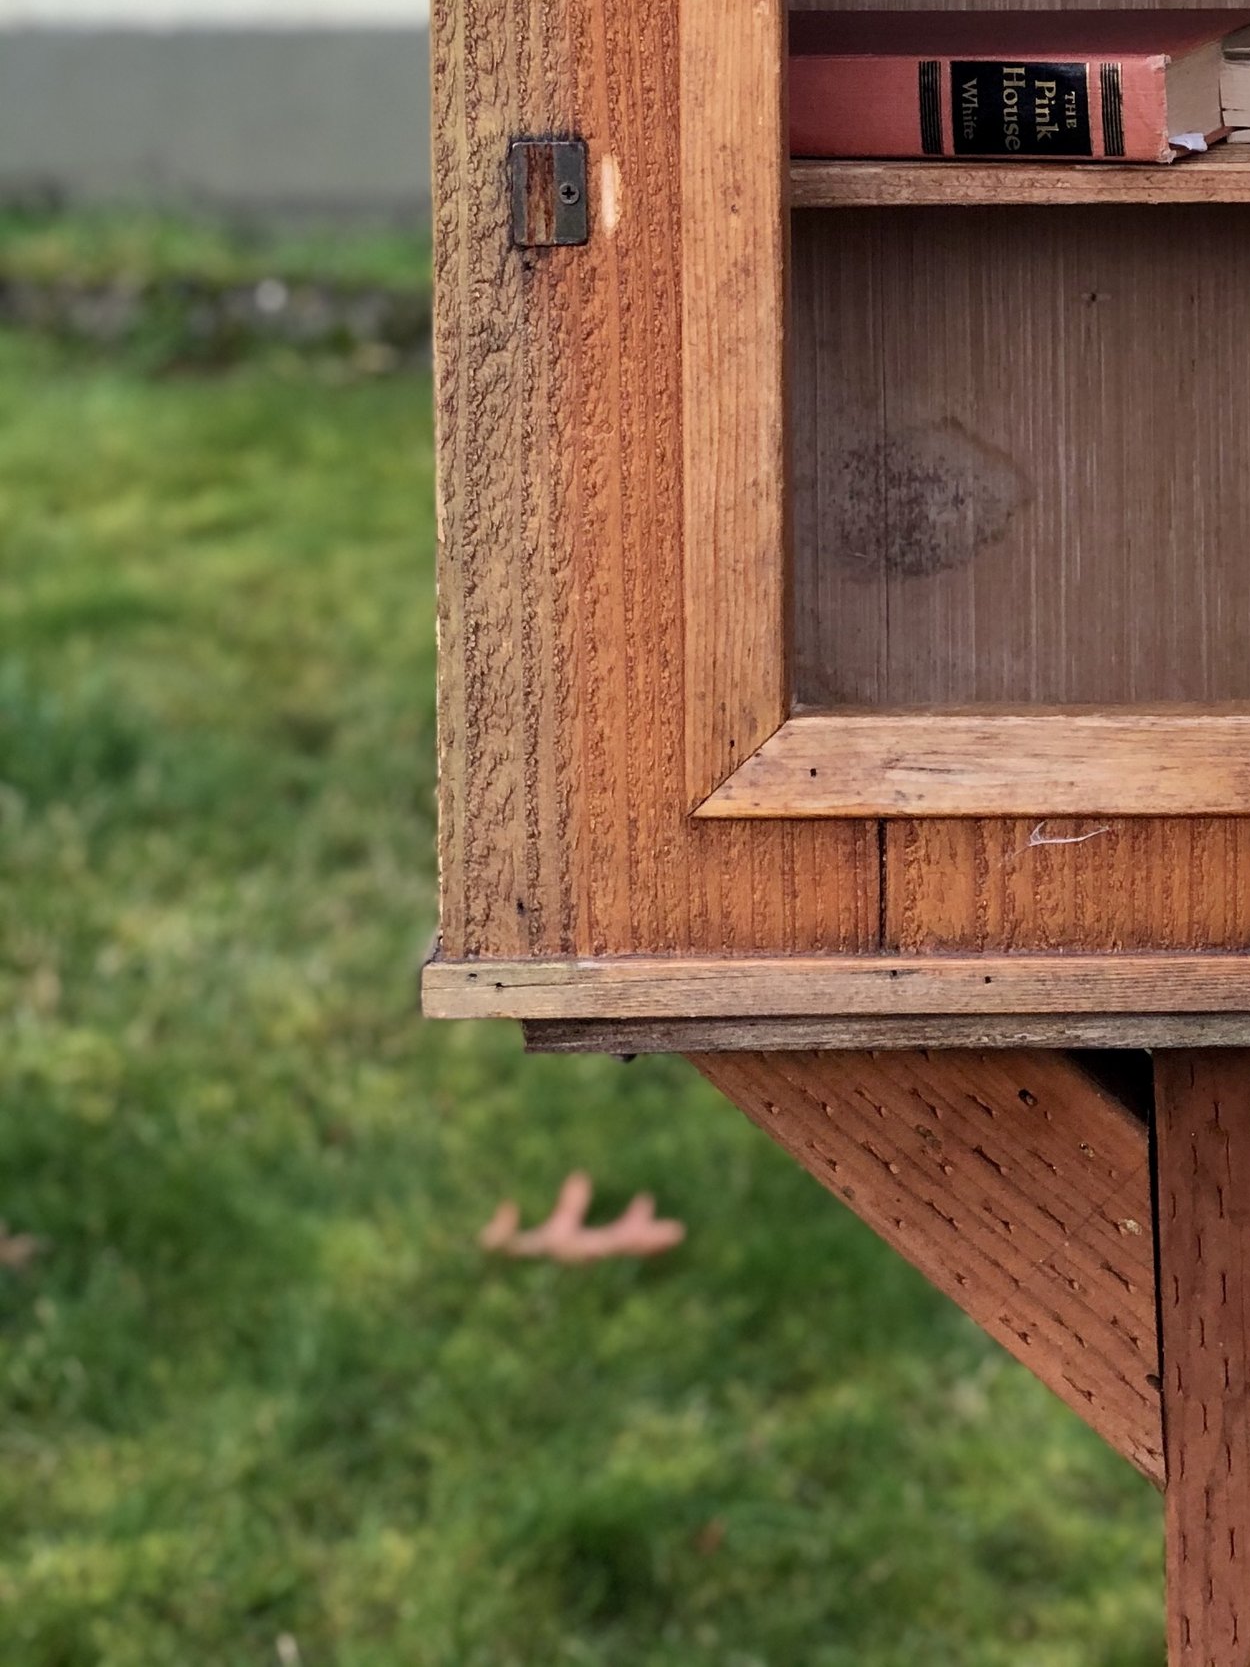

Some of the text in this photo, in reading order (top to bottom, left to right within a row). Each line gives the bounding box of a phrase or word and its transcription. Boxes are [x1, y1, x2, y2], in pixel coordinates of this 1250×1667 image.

[961, 77, 979, 140] White
[1002, 66, 1027, 151] House
[1034, 79, 1060, 142] Pink
[1064, 90, 1078, 129] THE
